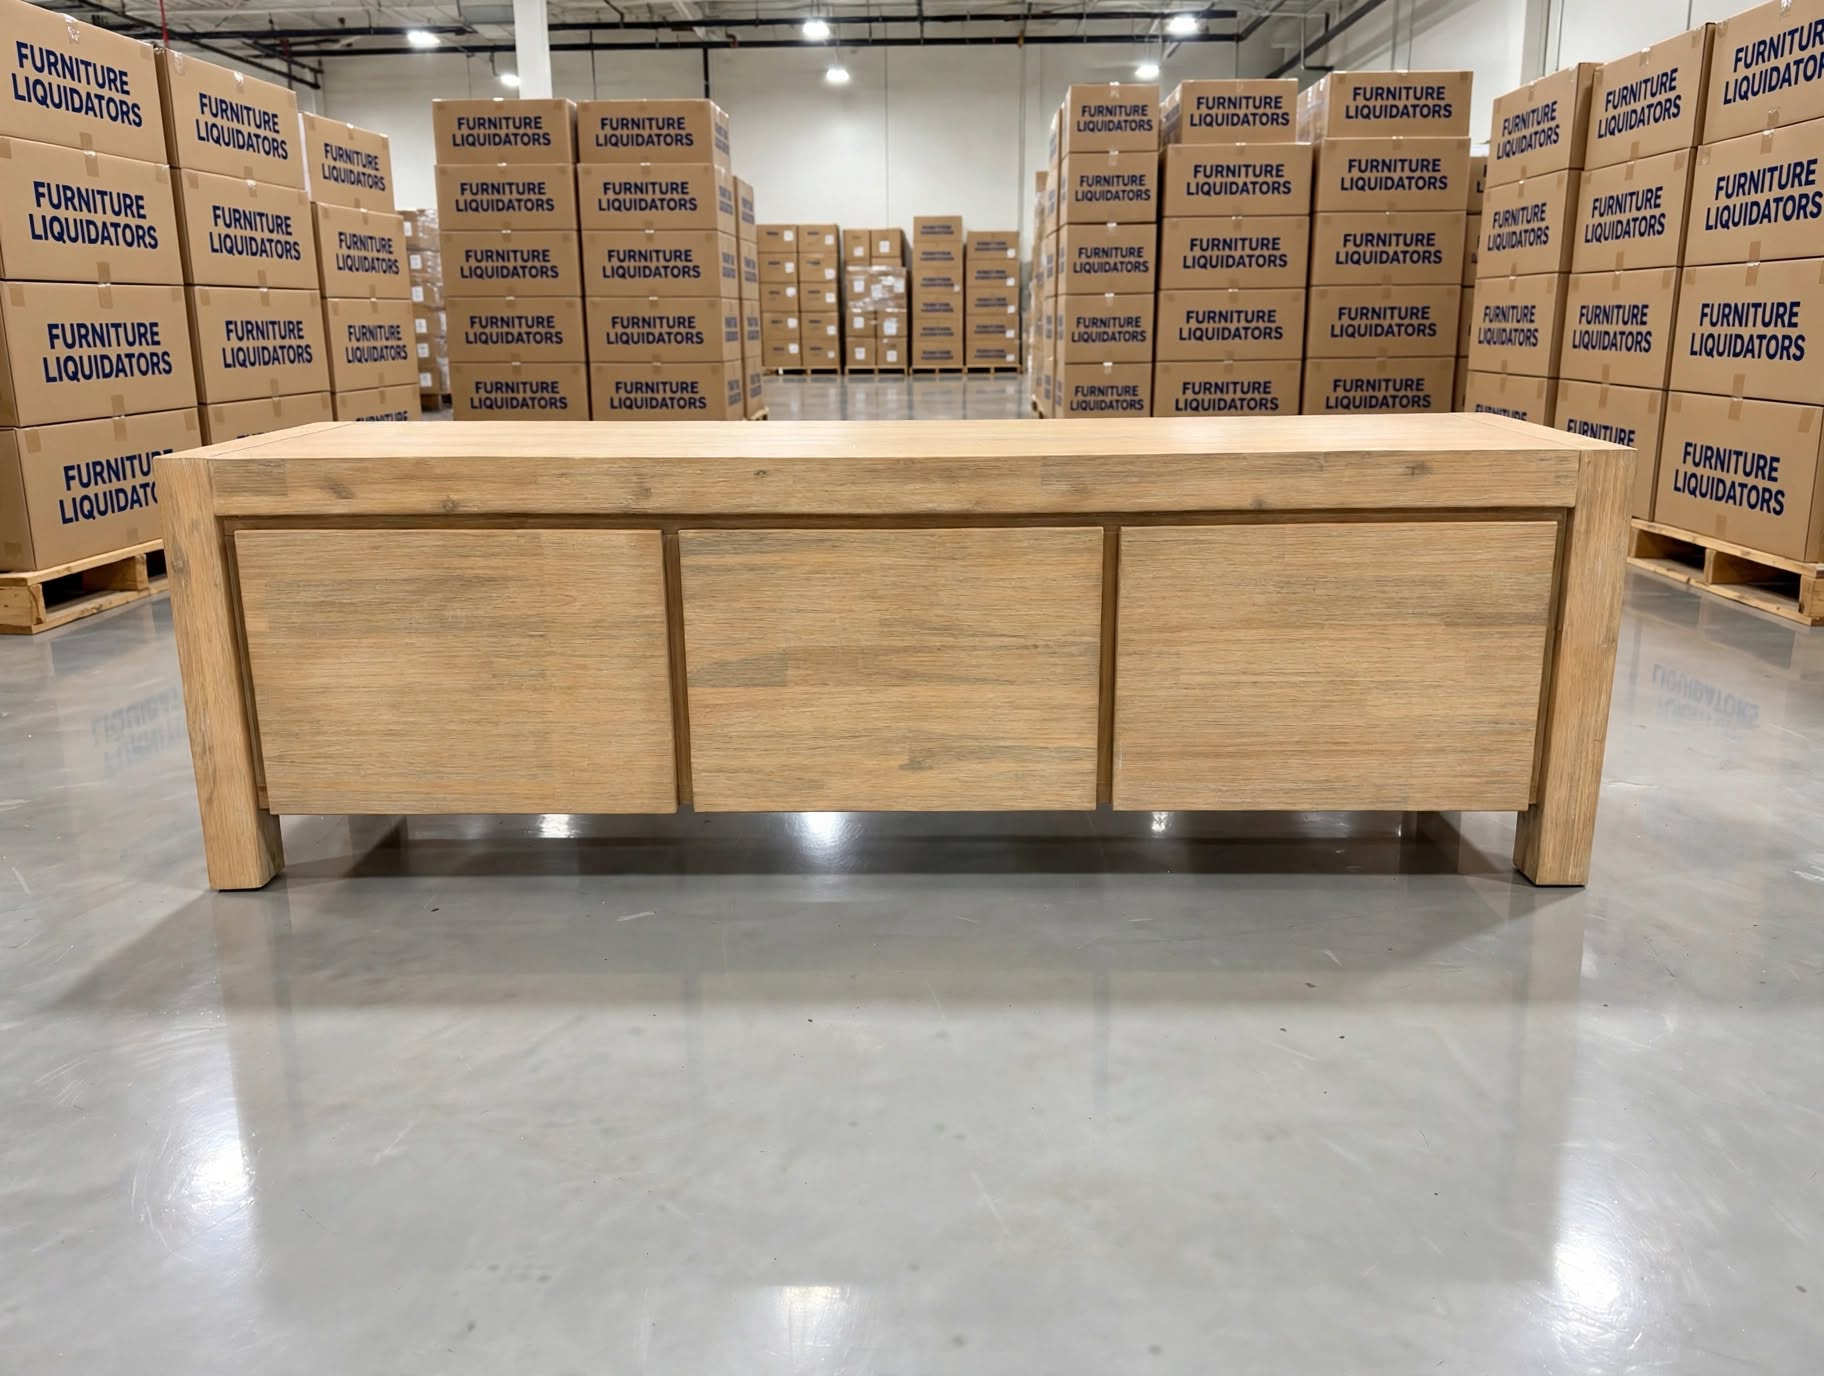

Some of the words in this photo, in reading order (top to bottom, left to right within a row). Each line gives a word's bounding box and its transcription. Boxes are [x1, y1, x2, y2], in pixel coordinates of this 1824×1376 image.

[1733, 17, 1824, 74] FURNITUR
[15, 40, 130, 96] FURNITURE
[1352, 86, 1445, 101] FURNITURE
[1605, 67, 1678, 110] FURNITURE
[11, 73, 143, 128] LIQUIDATORS
[1196, 95, 1282, 110] FURNITURE
[198, 92, 279, 134] FURNITURE
[1081, 104, 1148, 117] FURNITURE
[1345, 103, 1452, 119] LIQUIDATORS
[1597, 94, 1681, 138] LIQUIDATORS
[456, 116, 542, 130] FURNITURE
[600, 117, 685, 131] FURNITURE
[1077, 119, 1153, 132] LIQUIDATORS
[1189, 111, 1289, 128] LIQUIDATORS
[1502, 101, 1557, 137] FURNITURE
[195, 120, 289, 160] LIQUIDATORS
[452, 132, 551, 147] LIQUIDATORS
[595, 133, 693, 147] LIQUIDATORS
[1497, 124, 1560, 160] LIQUIDATORS
[324, 143, 379, 171] FURNITURE
[1193, 163, 1284, 179] FURNITURE
[1347, 158, 1441, 173] FURNITURE
[322, 163, 386, 191] LIQUIDATORS
[1079, 174, 1146, 187] FURNITURE
[1340, 175, 1448, 191] LIQUIDATORS
[1715, 158, 1818, 200] FURNITURE
[460, 181, 546, 195] FURNITURE
[603, 181, 688, 195] FURNITURE
[1075, 187, 1151, 201] LIQUIDATORS
[1186, 181, 1292, 196] LIQUIDATORS
[32, 180, 147, 220] FURNITURE
[455, 197, 554, 212] LIQUIDATORS
[598, 198, 697, 211] LIQUIDATORS
[1592, 185, 1663, 217] FURNITURE
[1493, 202, 1547, 229] FURNITURE
[1704, 190, 1824, 232] LIQUIDATORS
[211, 204, 292, 237] FURNITURE
[1584, 212, 1665, 243] LIQUIDATORS
[28, 213, 159, 250] LIQUIDATORS
[1343, 232, 1435, 247] FURNITURE
[1487, 226, 1549, 251] LIQUIDATORS
[208, 233, 301, 261] LIQUIDATORS
[338, 232, 393, 254] FURNITURE
[1189, 237, 1280, 252] FURNITURE
[464, 249, 550, 264] FURNITURE
[607, 249, 692, 263] FURNITURE
[1078, 247, 1143, 258] FURNITURE
[1335, 249, 1442, 265] LIQUIDATORS
[336, 253, 399, 275] LIQUIDATORS
[1073, 260, 1148, 273] LIQUIDATORS
[1183, 254, 1287, 270] LIQUIDATORS
[460, 264, 560, 278] LIQUIDATORS
[603, 265, 701, 279] LIQUIDATORS
[1185, 309, 1276, 325] FURNITURE
[1337, 304, 1430, 321] FURNITURE
[1484, 304, 1536, 324] FURNITURE
[1579, 303, 1648, 326] FURNITURE
[1699, 300, 1801, 329] FURNITURE
[224, 319, 304, 341] FURNITURE
[469, 316, 555, 329] FURNITURE
[611, 316, 695, 329] FURNITURE
[1076, 316, 1141, 328] FURNITURE
[1330, 322, 1436, 338] LIQUIDATORS
[47, 321, 161, 351] FURNITURE
[348, 325, 402, 341] FURNITURE
[465, 331, 562, 344] LIQUIDATORS
[607, 331, 704, 345] LIQUIDATORS
[1072, 329, 1146, 343] LIQUIDATORS
[1179, 325, 1283, 341] LIQUIDATORS
[1478, 327, 1538, 347] LIQUIDATORS
[1573, 330, 1652, 353] LIQUIDATORS
[1689, 332, 1805, 362] LIQUIDATORS
[223, 343, 312, 369] LIQUIDATORS
[346, 344, 408, 363] LIQUIDATORS
[42, 351, 173, 384] LIQUIDATORS
[474, 381, 559, 394] FURNITURE
[615, 381, 699, 394] FURNITURE
[1075, 385, 1138, 396] FURNITURE
[1182, 381, 1271, 395] FURNITURE
[1333, 378, 1424, 391] FURNITURE
[470, 396, 567, 409] LIQUIDATORS
[609, 396, 706, 408] LIQUIDATORS
[1070, 398, 1144, 411] LIQUIDATORS
[1174, 397, 1278, 411] LIQUIDATORS
[1326, 394, 1431, 409] LIQUIDATORS
[63, 448, 173, 491] FURNITU
[1682, 441, 1781, 483] FURNITURE
[1673, 472, 1786, 516] LIQUIDATORS
[58, 482, 158, 525] LIQUIDAT
